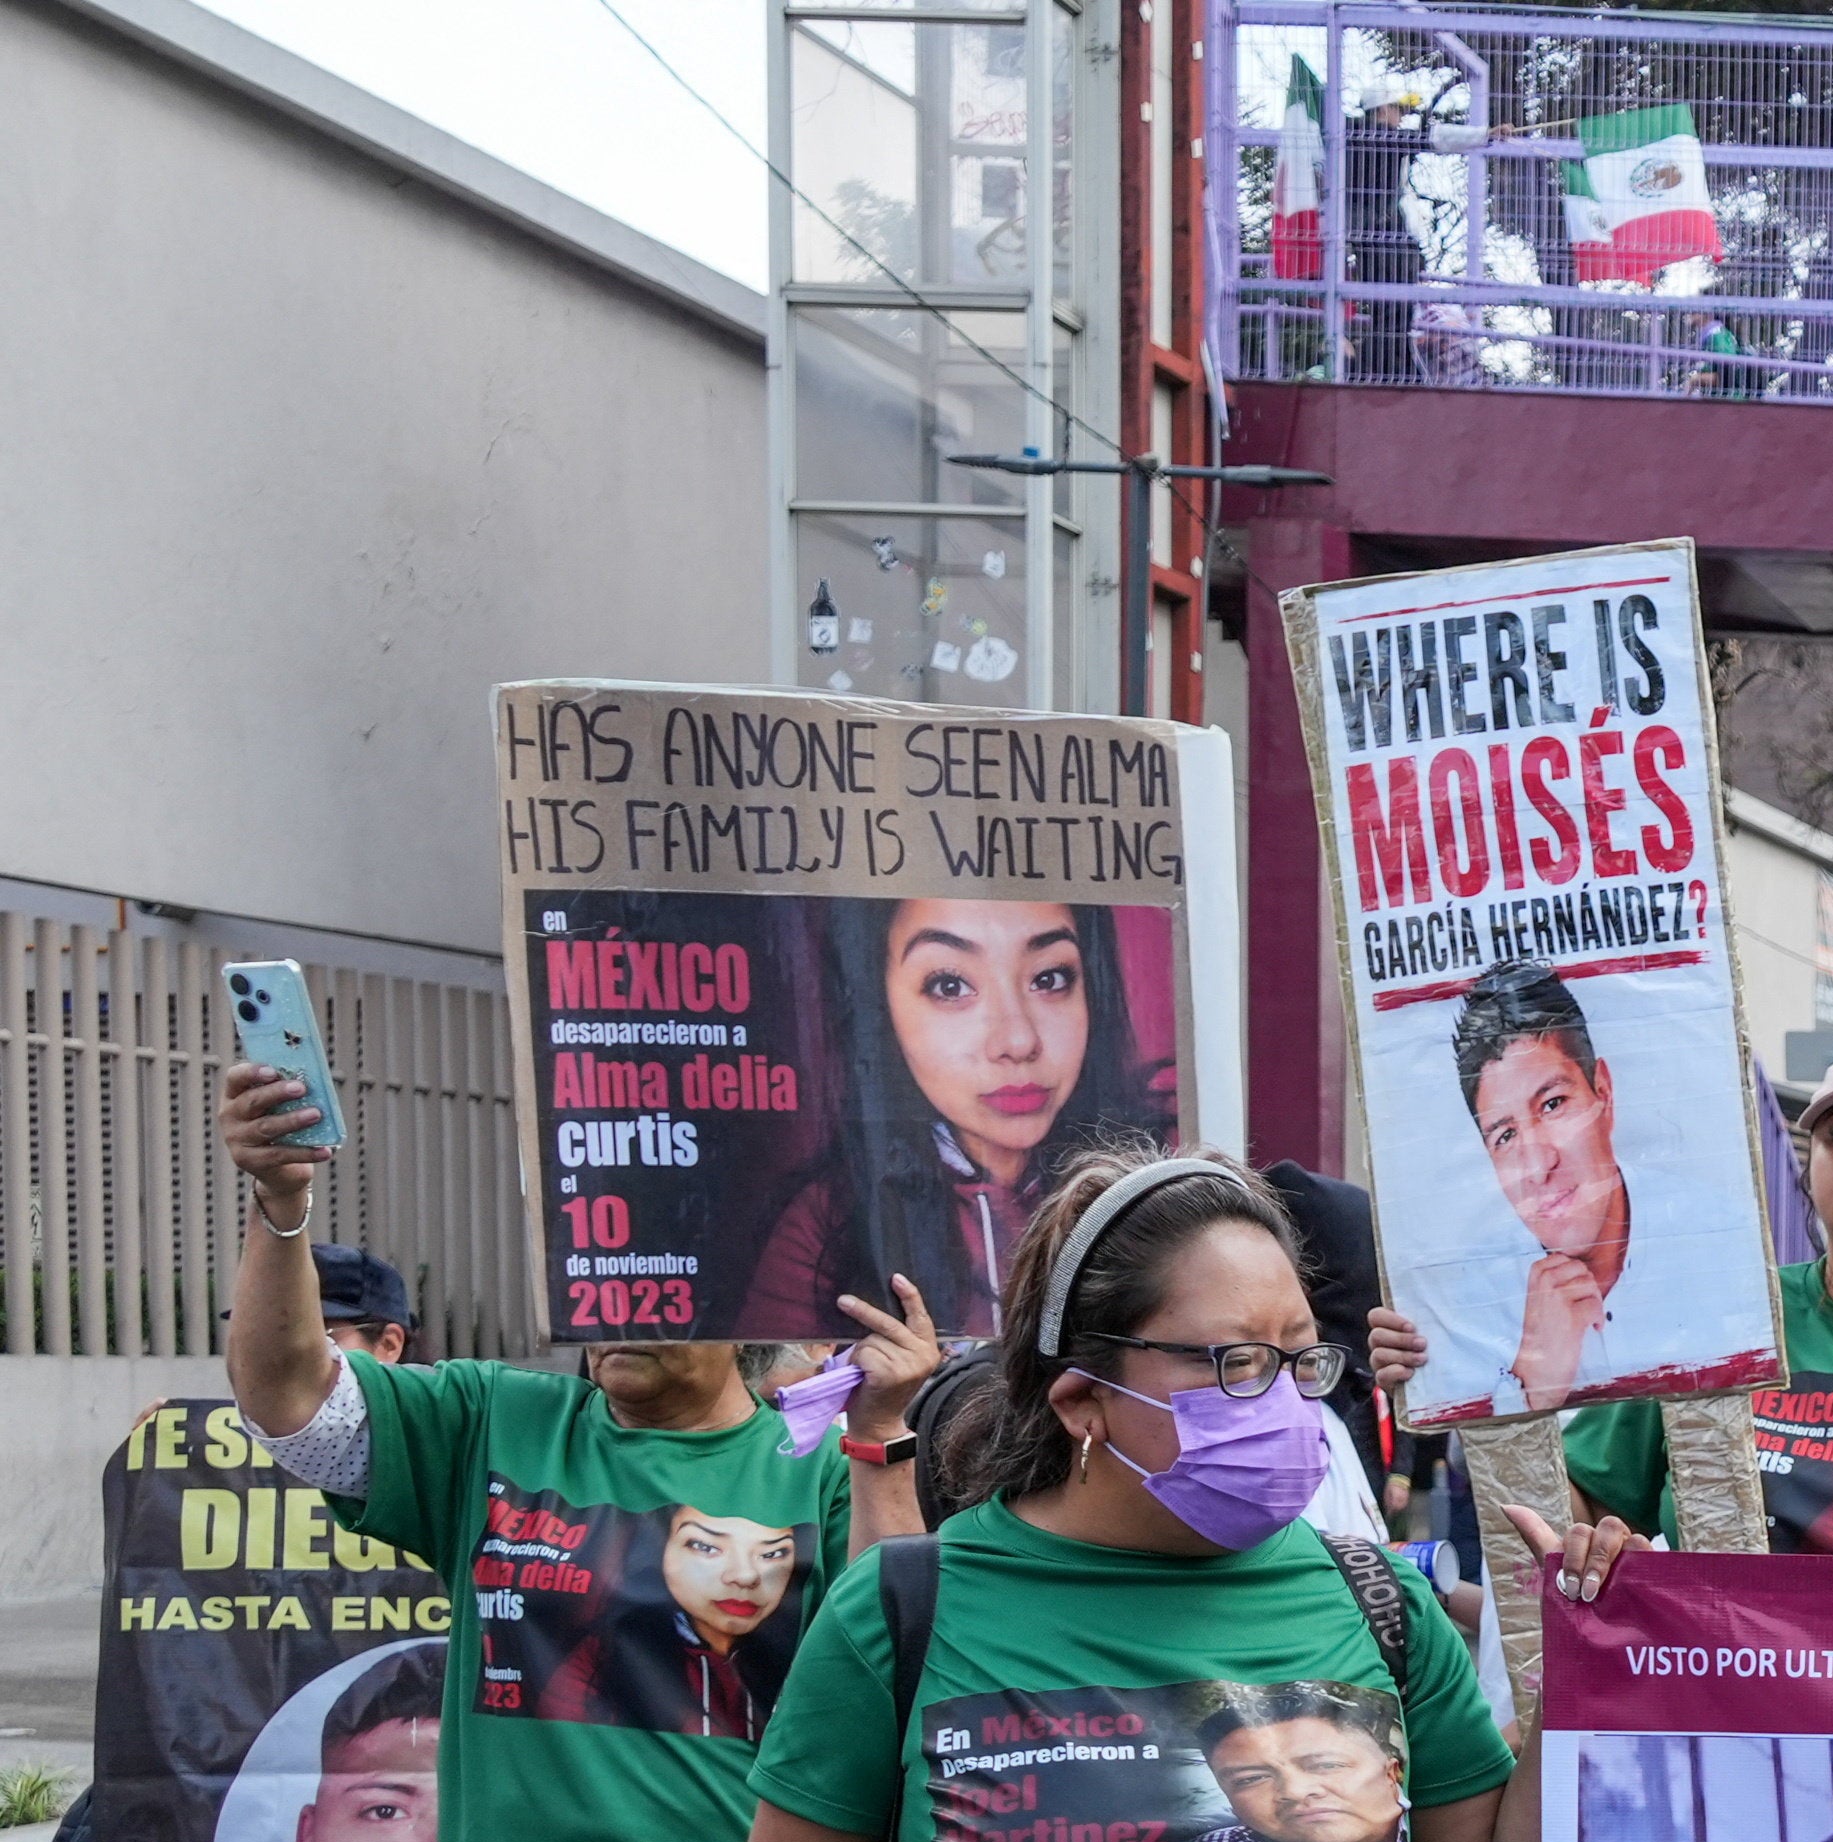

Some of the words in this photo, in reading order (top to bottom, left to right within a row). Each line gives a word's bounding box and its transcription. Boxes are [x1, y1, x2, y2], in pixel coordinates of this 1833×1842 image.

[1328, 604, 1575, 751] WHERE
[1594, 594, 1664, 718] IS
[506, 703, 631, 783] HAS
[663, 708, 876, 793] ANYONE
[906, 724, 1045, 806] SEEN
[1060, 734, 1171, 807] ALMA
[1344, 706, 1697, 913] MOISÉS
[508, 798, 604, 875] HIS
[629, 798, 846, 875] FAMILY
[865, 808, 906, 876] IS
[928, 810, 1183, 885] WAITING
[543, 907, 566, 932] en
[1364, 905, 1483, 982] GARCÍA
[1489, 879, 1707, 962] HERNÁNDEZ?
[546, 926, 749, 1012] MÉXICO
[551, 1021, 727, 1052] desaparecieron
[732, 1027, 747, 1047] a
[553, 1053, 668, 1111] Alma
[682, 1058, 797, 1112] delia
[558, 1114, 698, 1168] curtis
[561, 1174, 577, 1194] el
[561, 1195, 629, 1248] 10
[566, 1252, 589, 1275] de
[595, 1251, 698, 1275] noviembre
[569, 1280, 693, 1325] 2023
[120, 1596, 311, 1632] HASTA
[1626, 1646, 1709, 1678] VISTO
[1716, 1648, 1778, 1680] POR
[936, 1727, 971, 1754] En
[981, 1709, 1144, 1745] México
[941, 1742, 1135, 1778] Desaparecieron
[1142, 1744, 1159, 1760] a
